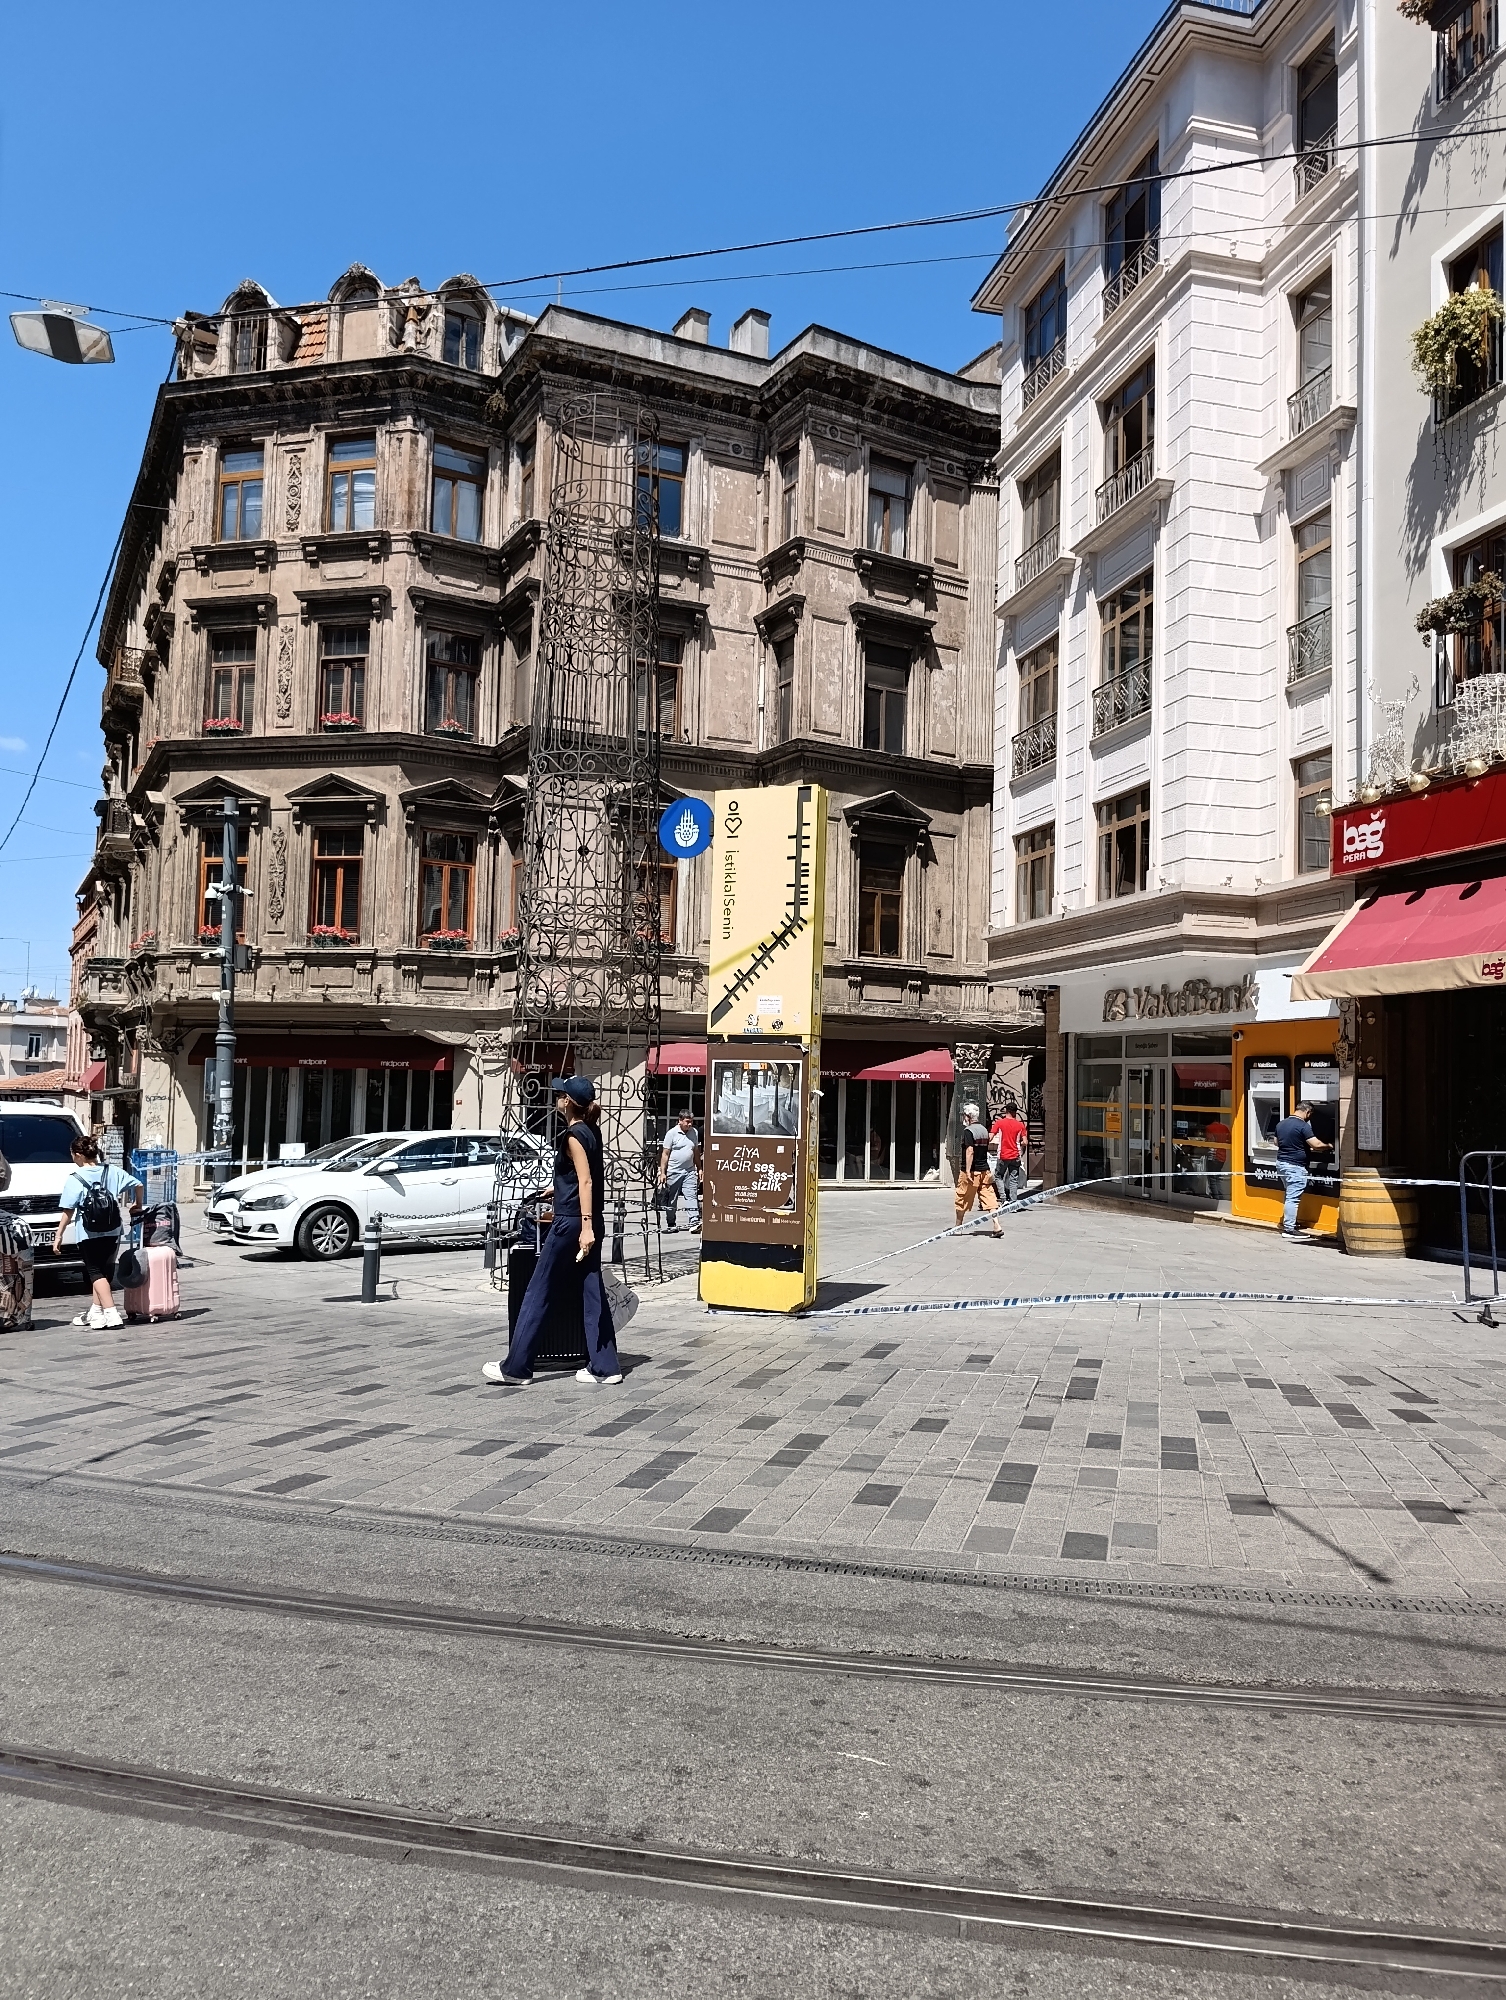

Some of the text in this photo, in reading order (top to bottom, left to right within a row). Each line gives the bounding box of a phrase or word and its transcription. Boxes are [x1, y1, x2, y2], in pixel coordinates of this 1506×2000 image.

[1343, 809, 1386, 859] bağ
[1342, 851, 1366, 864] PERA
[1481, 957, 1506, 981] bağ
[299, 1058, 327, 1066] midpoint
[380, 1060, 410, 1068] midpoint
[667, 1065, 701, 1074] midpoint
[900, 1072, 930, 1080] midpoint
[733, 1144, 760, 1159] ZİYA
[715, 1157, 775, 1173] TACİR ses
[751, 1178, 783, 1192] sizlik
